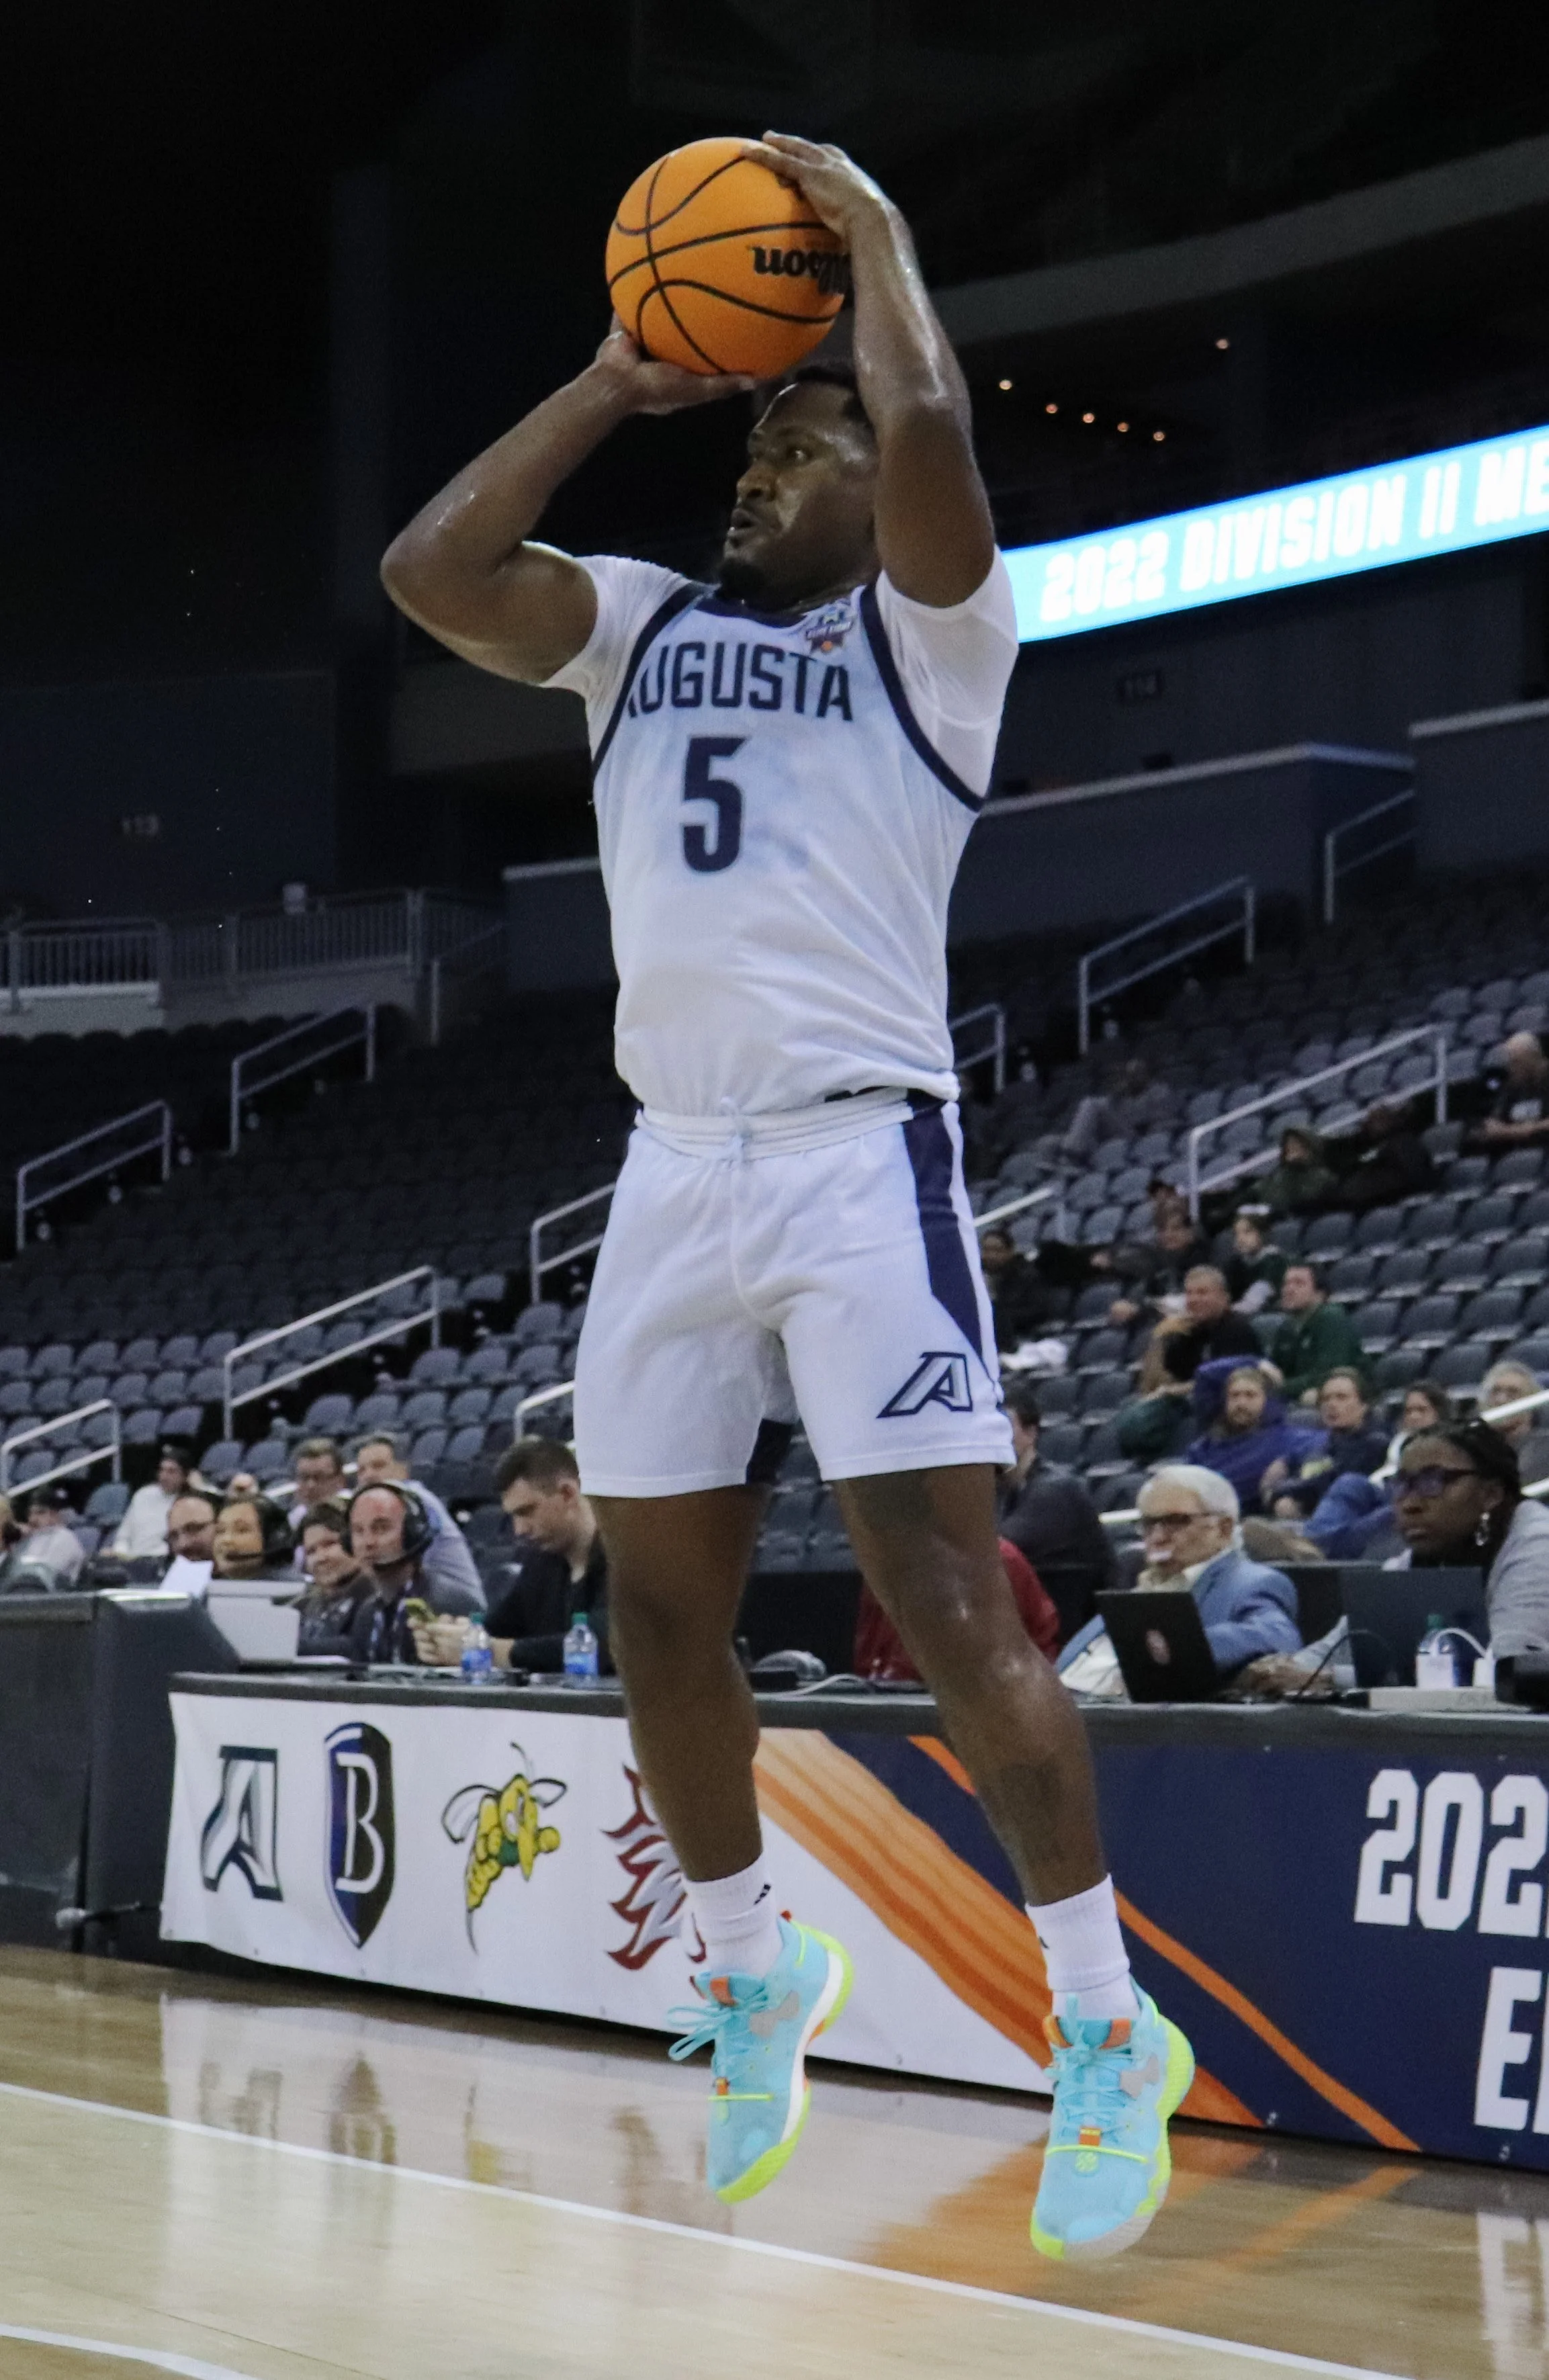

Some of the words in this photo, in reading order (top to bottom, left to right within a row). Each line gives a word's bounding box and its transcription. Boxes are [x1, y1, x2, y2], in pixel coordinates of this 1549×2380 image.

[1040, 531, 1169, 623] 2022
[1180, 474, 1407, 592] DIVISION
[1419, 461, 1460, 539] II
[680, 736, 748, 873] 5
[1354, 1769, 1549, 1937] 202
